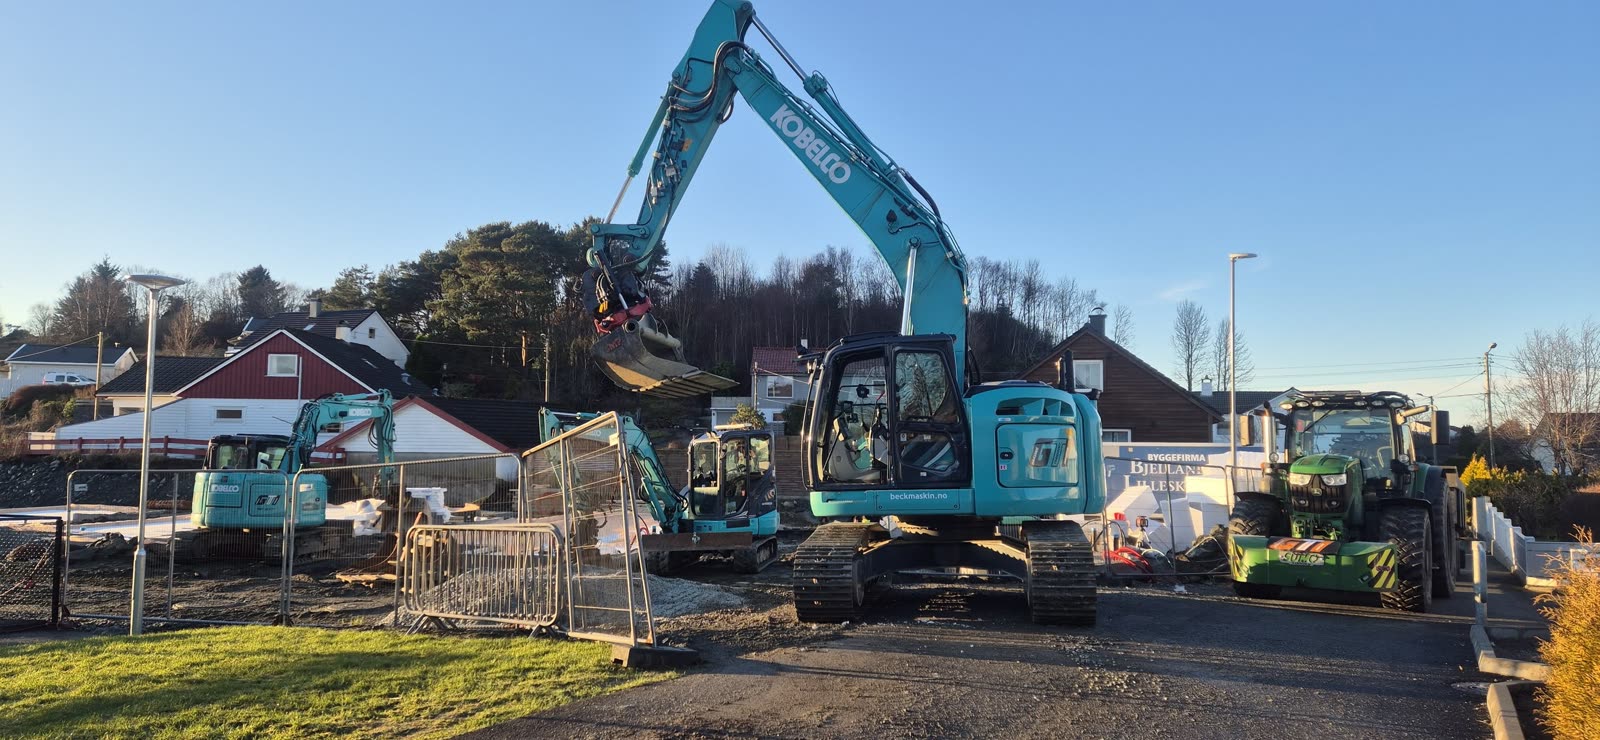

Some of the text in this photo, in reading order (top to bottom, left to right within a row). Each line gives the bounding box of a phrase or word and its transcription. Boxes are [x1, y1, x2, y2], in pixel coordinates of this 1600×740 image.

[769, 103, 851, 184] KOBELCO
[1147, 453, 1206, 462] BYGGEFIRMA
[1130, 458, 1204, 476] BJELLAN
[890, 491, 948, 500] beckmaskin.no
